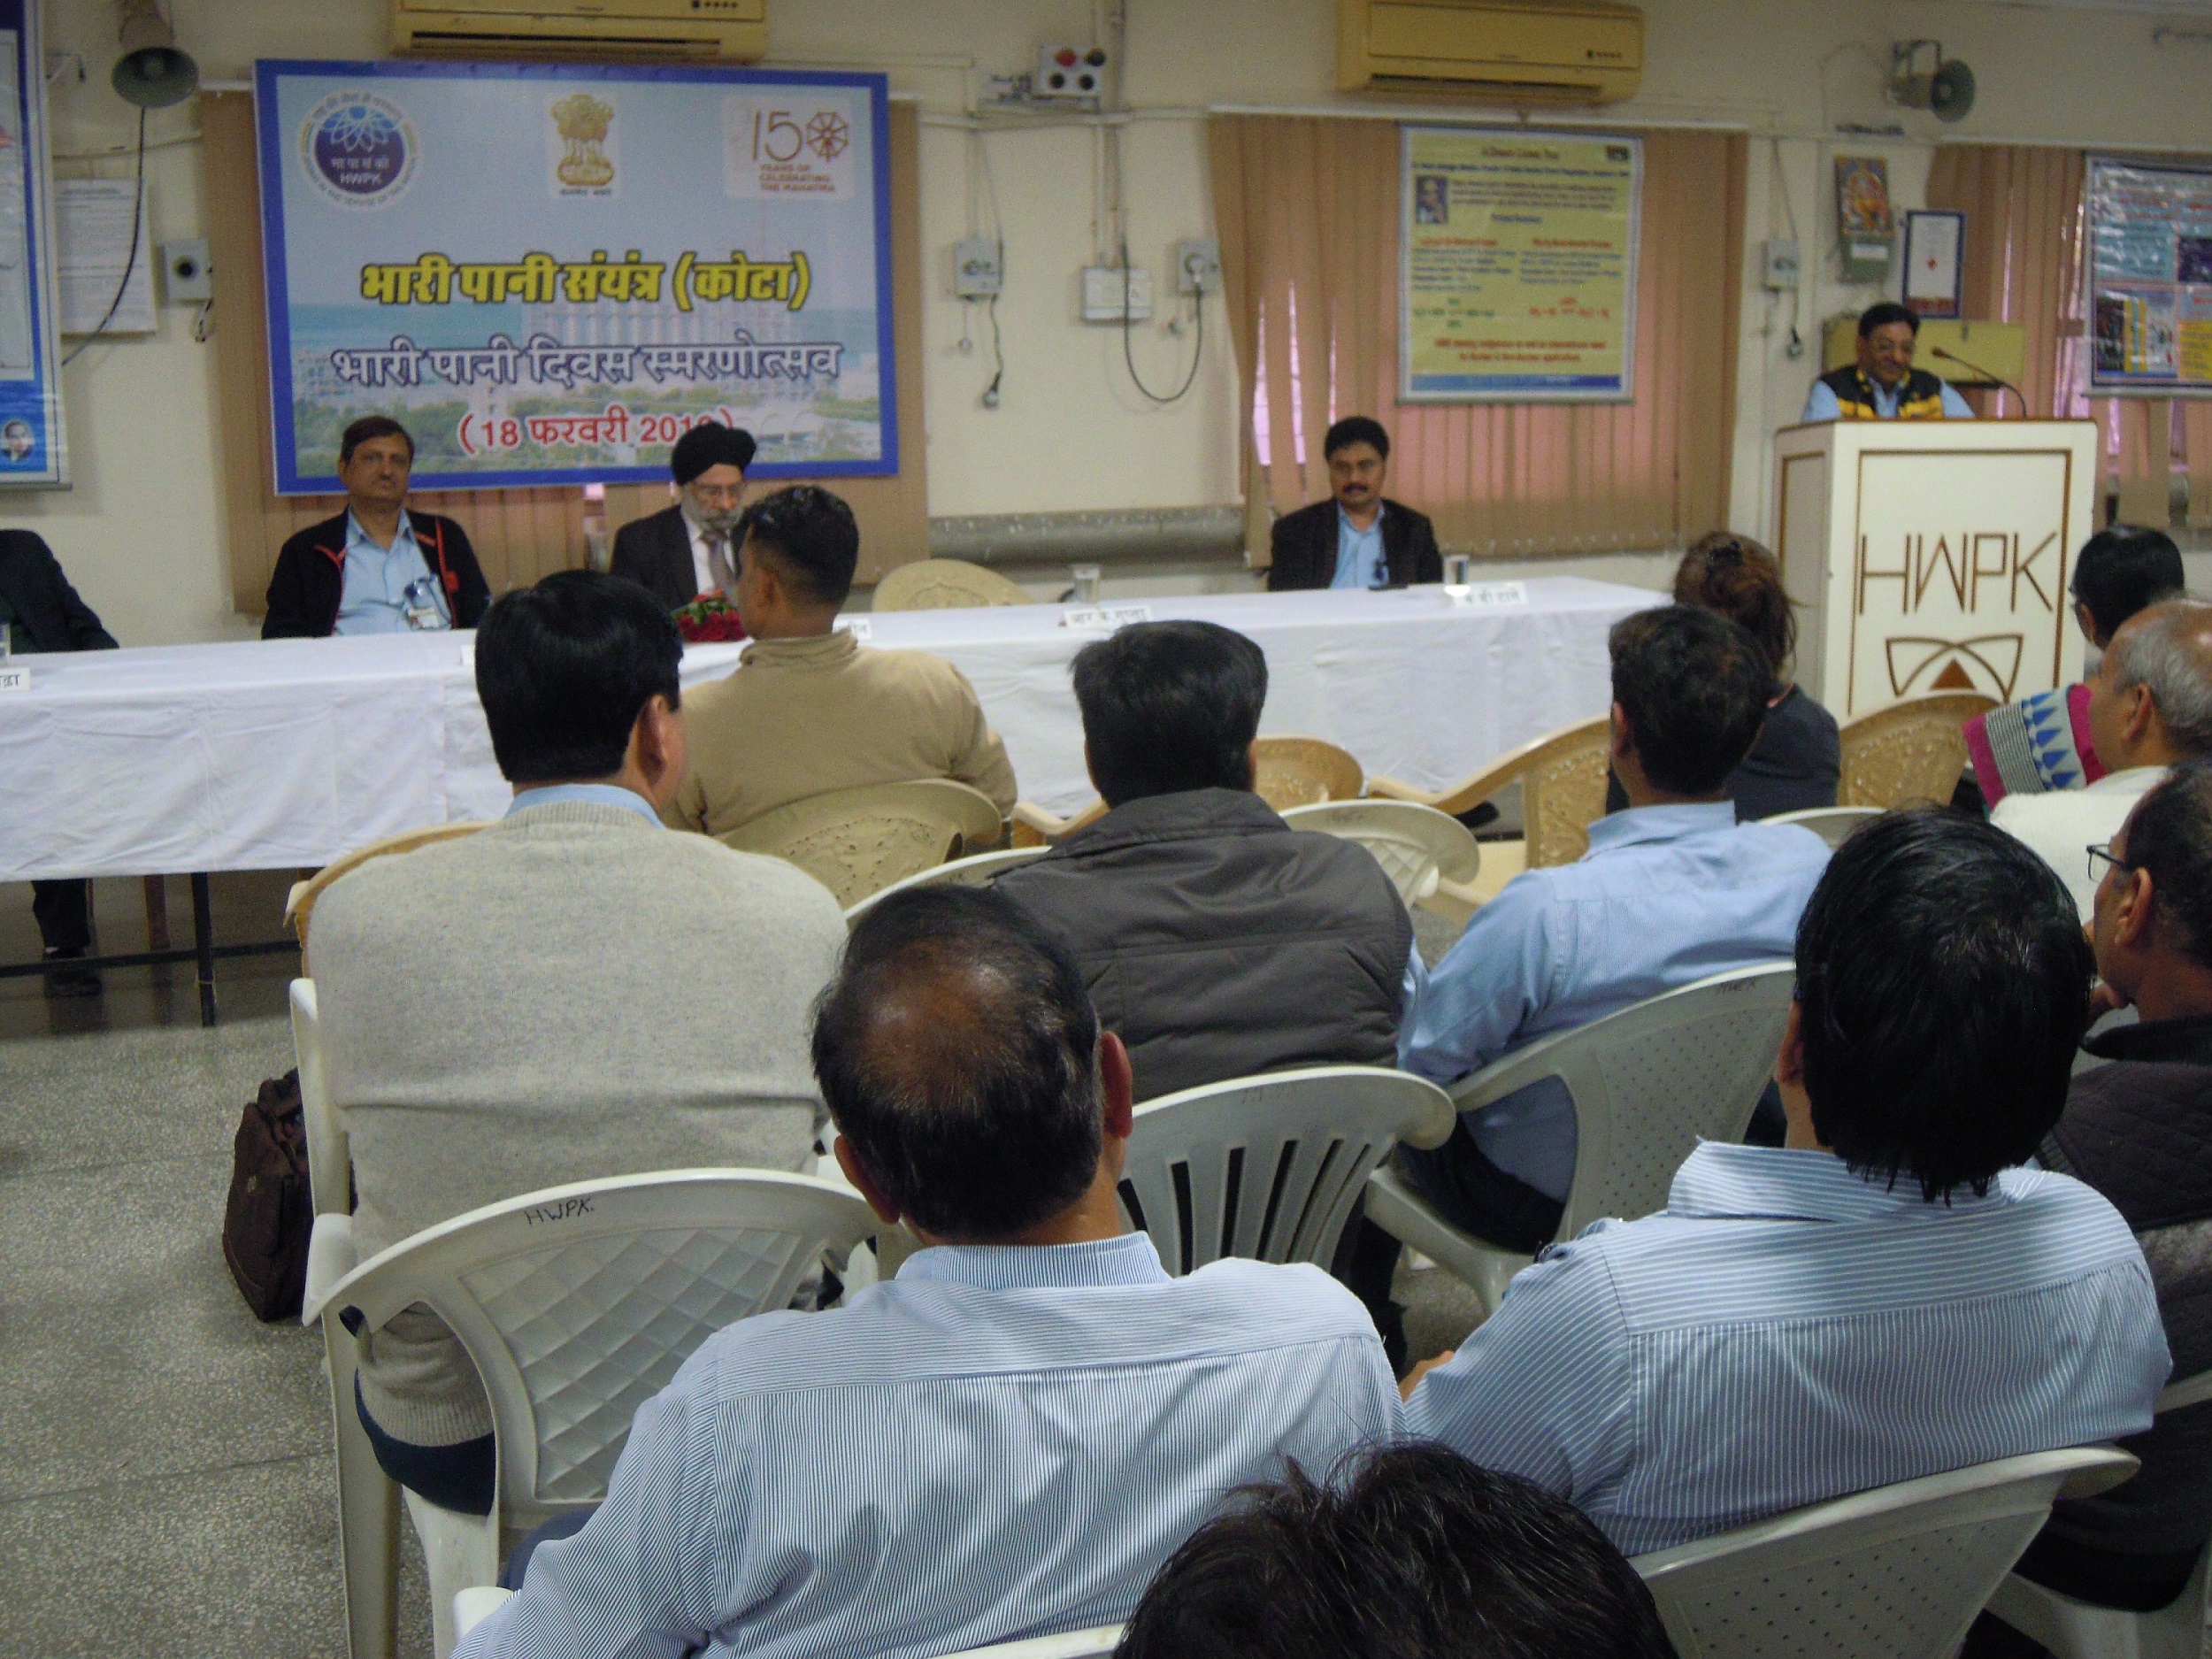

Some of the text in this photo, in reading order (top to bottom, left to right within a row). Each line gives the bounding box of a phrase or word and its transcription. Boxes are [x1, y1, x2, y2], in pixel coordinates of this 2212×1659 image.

[360, 250, 810, 311] भारी पानी संयंत्र (कोटा)
[330, 327, 844, 390] भारी पानी दिवस स्मरणोत्सव
[527, 403, 629, 443] फरवरी
[1859, 531, 2058, 616] HWPK
